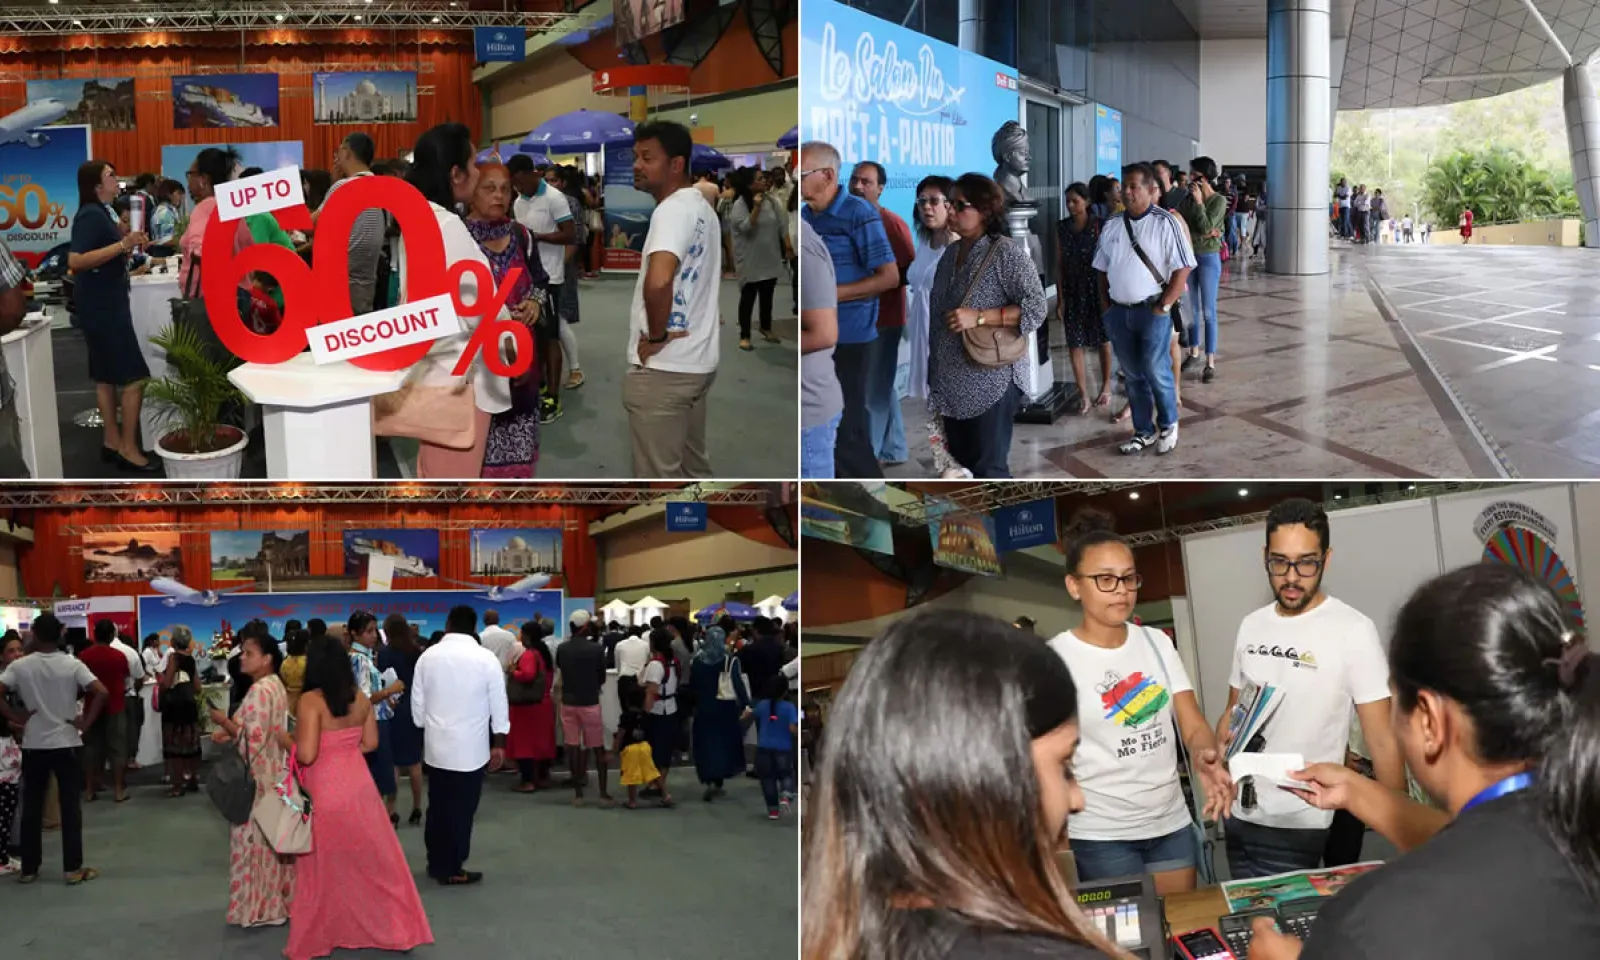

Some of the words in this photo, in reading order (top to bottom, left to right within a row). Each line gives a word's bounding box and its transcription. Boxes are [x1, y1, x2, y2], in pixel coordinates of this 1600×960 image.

[486, 42, 515, 52] Hilton
[820, 21, 850, 101] Le
[855, 31, 918, 105] Salon
[229, 187, 258, 208] UP
[261, 179, 291, 200] TO
[7, 232, 59, 242] DISCOUNT
[324, 307, 440, 353] DISCOUNT
[1009, 523, 1043, 537] Hilton
[1121, 738, 1138, 747] Mo
[1141, 733, 1151, 741] Ti
[1117, 747, 1137, 758] Mo
